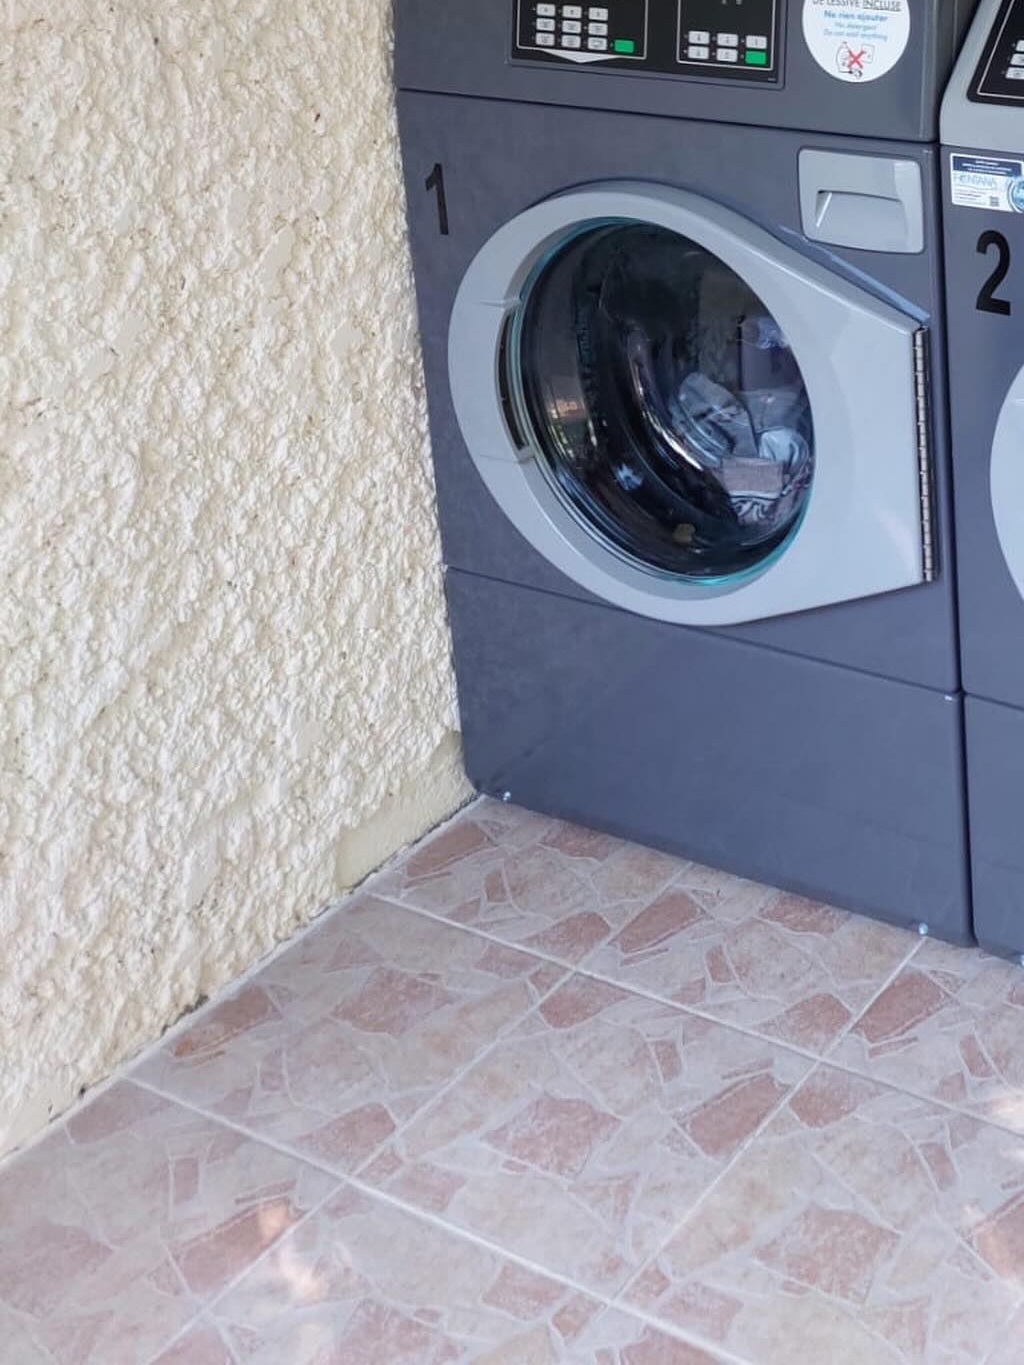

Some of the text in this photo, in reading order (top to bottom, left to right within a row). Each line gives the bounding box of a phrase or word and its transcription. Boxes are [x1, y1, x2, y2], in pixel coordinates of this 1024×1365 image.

[863, 0, 901, 12] INCLUSE
[425, 163, 449, 236] 1
[975, 229, 1011, 316] 2
